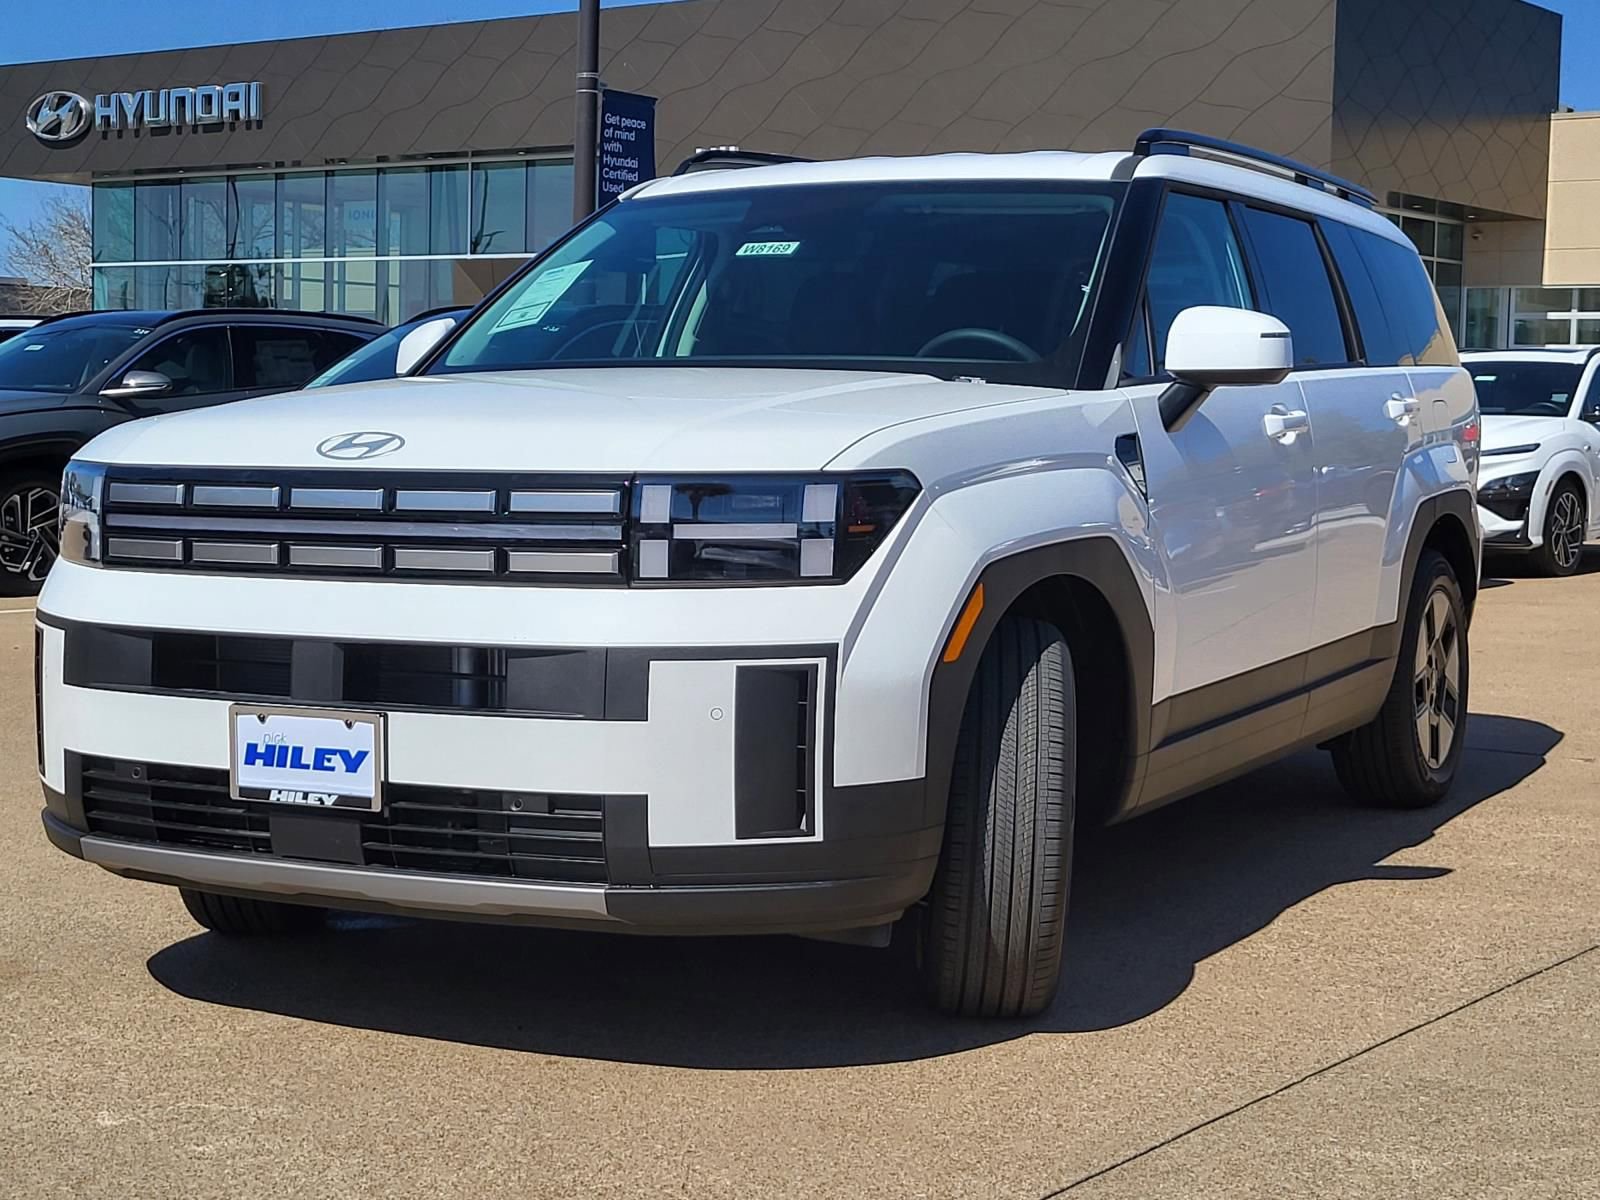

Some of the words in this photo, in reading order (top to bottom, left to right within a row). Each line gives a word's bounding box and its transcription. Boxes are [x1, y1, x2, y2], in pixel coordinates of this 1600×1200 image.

[95, 82, 263, 130] HYUNDAI
[605, 113, 620, 125] Get
[621, 117, 646, 129] peace
[604, 127, 613, 137] of
[614, 128, 635, 141] mind
[603, 141, 622, 152] with
[603, 154, 638, 168] Hyundai
[603, 168, 638, 181] Certified
[603, 181, 624, 193] Used
[742, 243, 791, 254] W8169
[244, 742, 370, 773] HILEY
[269, 789, 339, 806] HILEY
